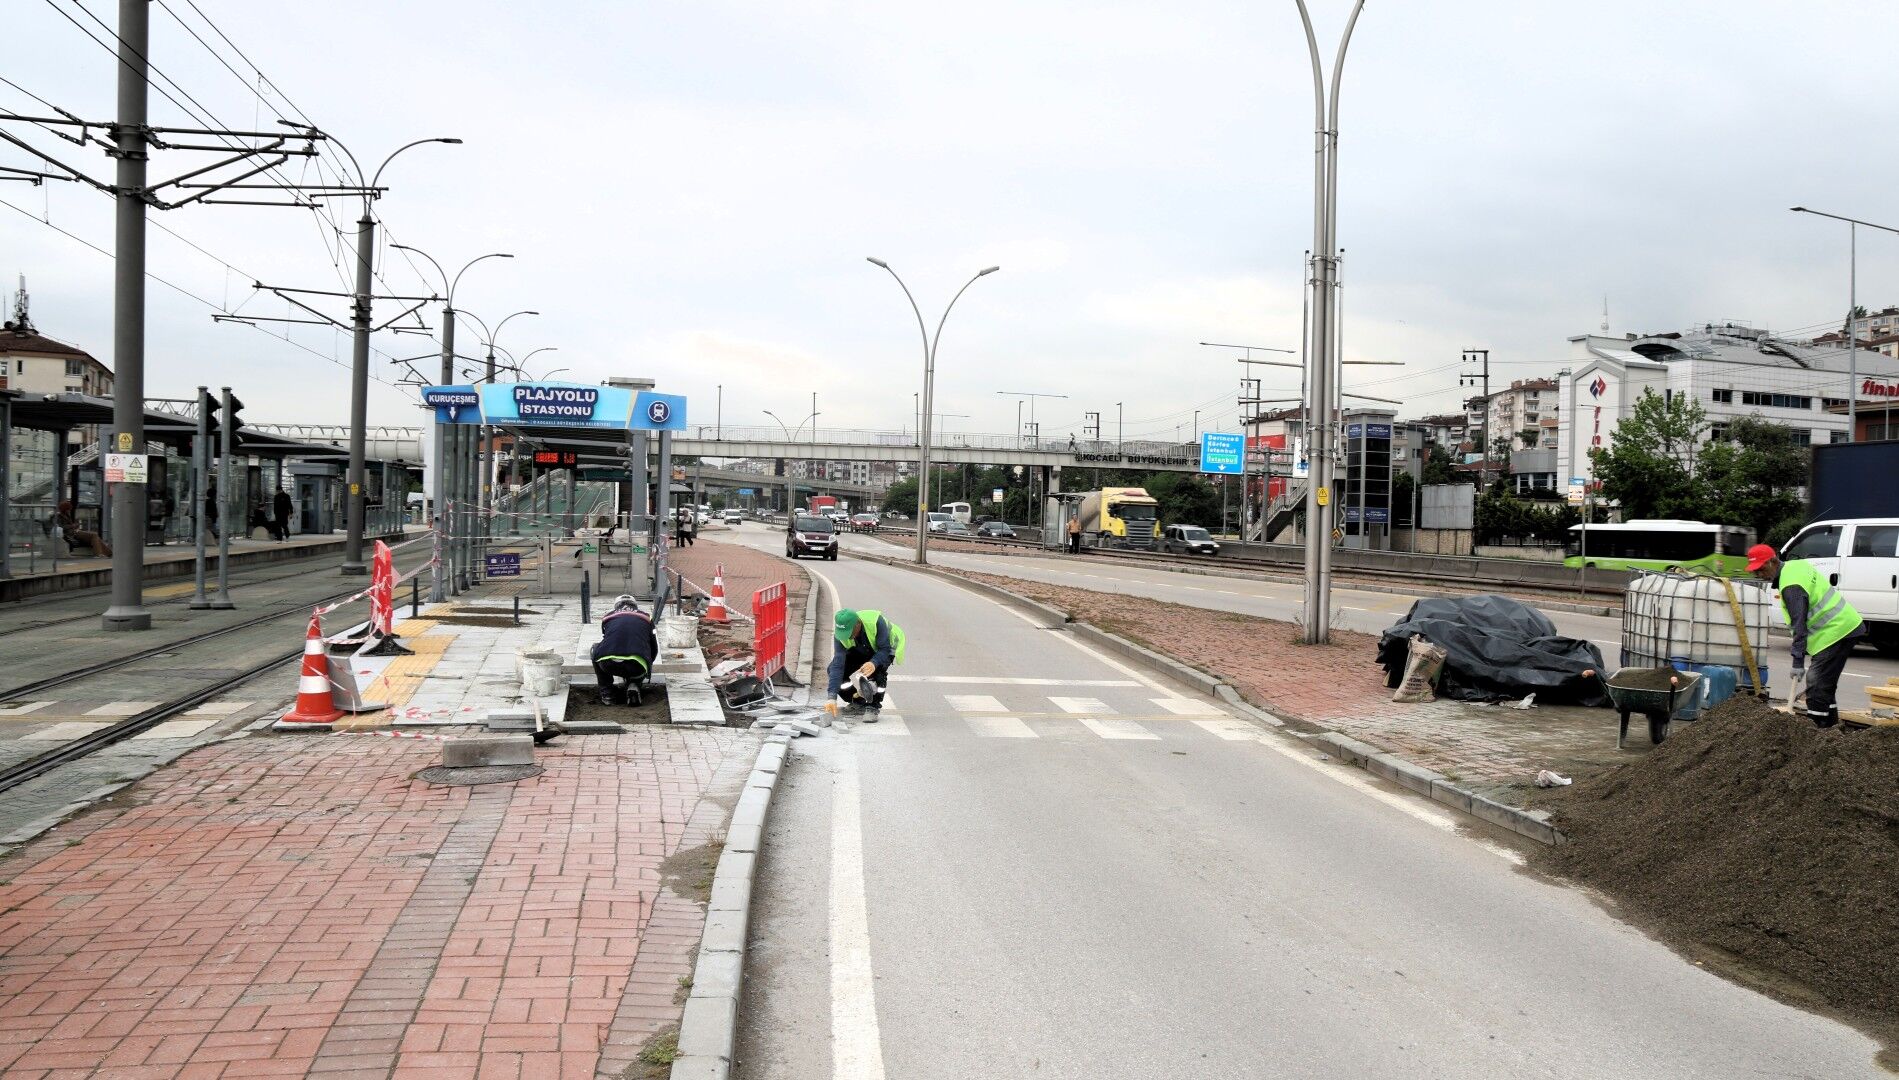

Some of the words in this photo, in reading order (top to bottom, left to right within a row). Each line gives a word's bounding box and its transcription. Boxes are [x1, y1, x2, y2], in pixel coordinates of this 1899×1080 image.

[428, 394, 476, 404] KURUÇEŞME
[515, 388, 597, 402] PLAJYOLU
[519, 402, 592, 416] İSTASYONU
[1083, 453, 1122, 463] KOCAELİ
